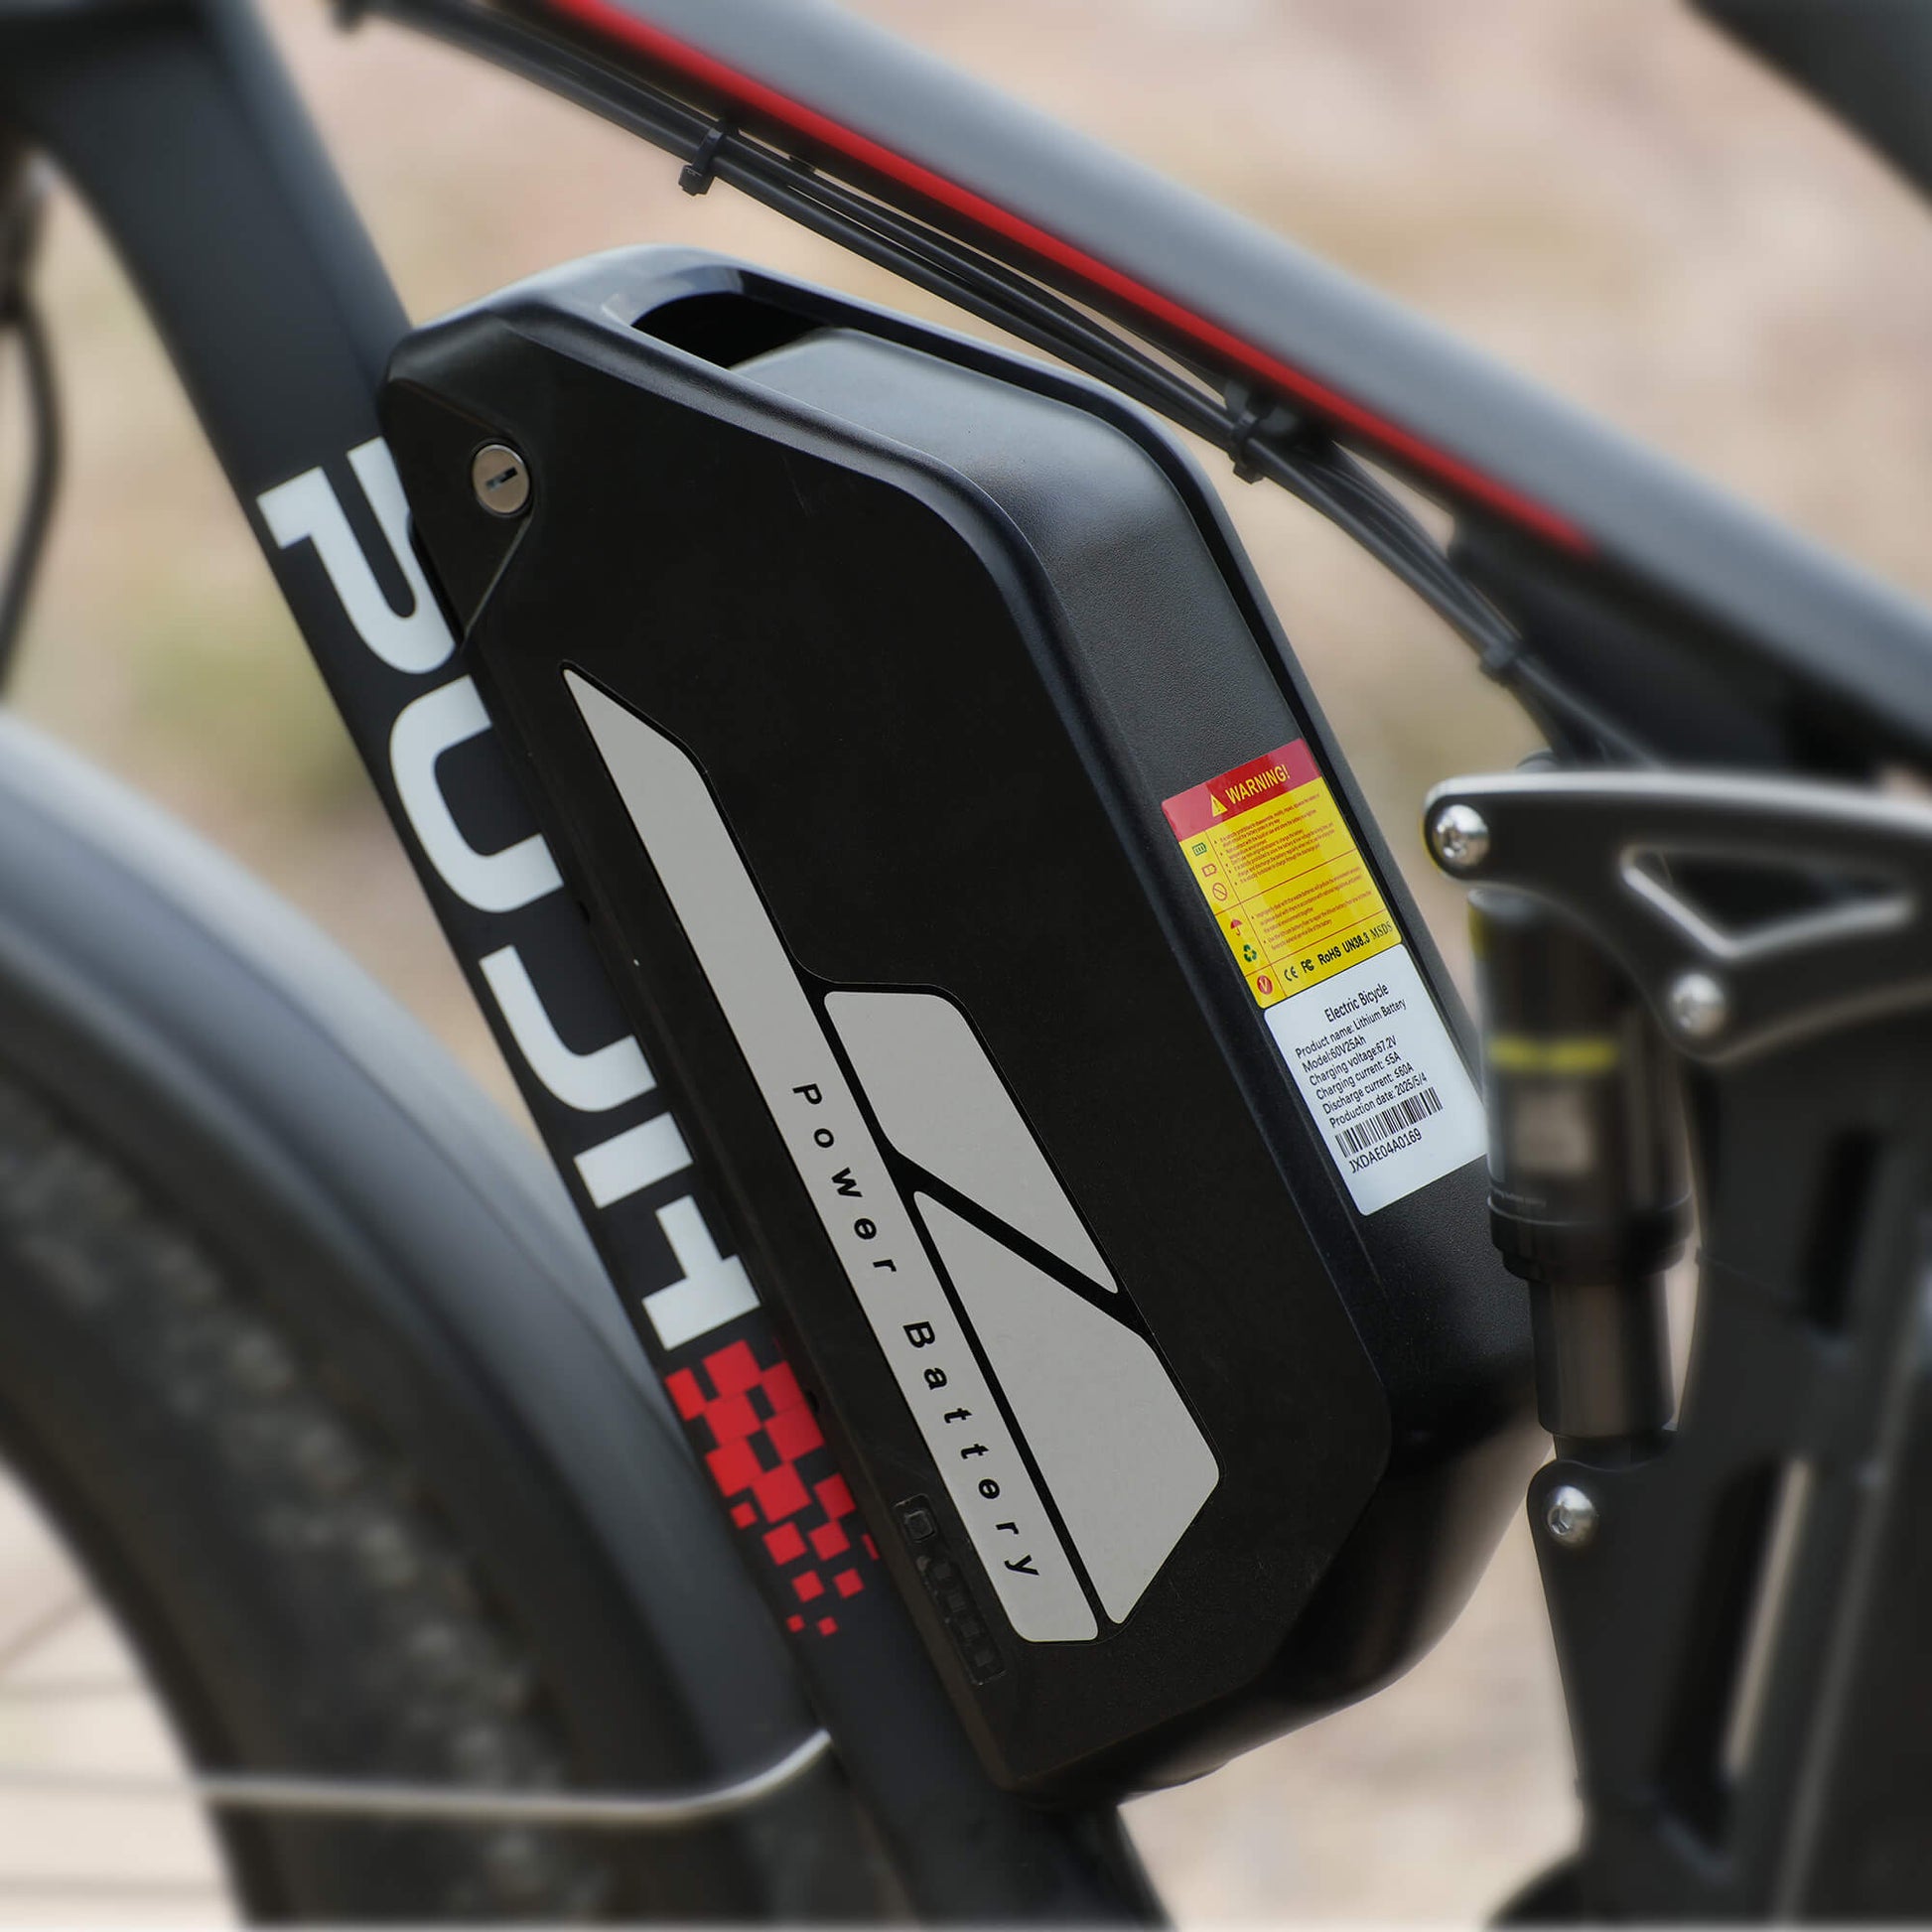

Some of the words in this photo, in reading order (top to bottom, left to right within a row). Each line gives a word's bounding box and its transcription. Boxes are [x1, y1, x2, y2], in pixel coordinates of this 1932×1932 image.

[1225, 764, 1290, 804] WARNING!
[1317, 946, 1341, 965] RoHS
[1341, 932, 1370, 953] UN38.3
[1369, 921, 1392, 940] MSDS
[1324, 998, 1359, 1023] Electric
[1358, 984, 1389, 1006] Bicycle
[1295, 1036, 1330, 1059] Product
[1329, 1026, 1354, 1042] name:
[1352, 1012, 1382, 1031] Lithium
[1380, 1000, 1406, 1017] Battery
[1302, 1035, 1366, 1072] Model:60V25Ah
[1310, 1062, 1349, 1086] Charging
[1316, 1076, 1355, 1100] Charging
[1355, 1061, 1385, 1081] current:
[1322, 1089, 1364, 1115] Discharge
[1364, 1073, 1394, 1094] current:
[1329, 1100, 1376, 1129] Production
[1376, 1091, 1394, 1105] date:
[1394, 1072, 1427, 1096] 2025/5/4
[1349, 1128, 1422, 1173] JXDAE04A0169
[792, 1082, 897, 1273] Power
[902, 1319, 1040, 1576] Battery
